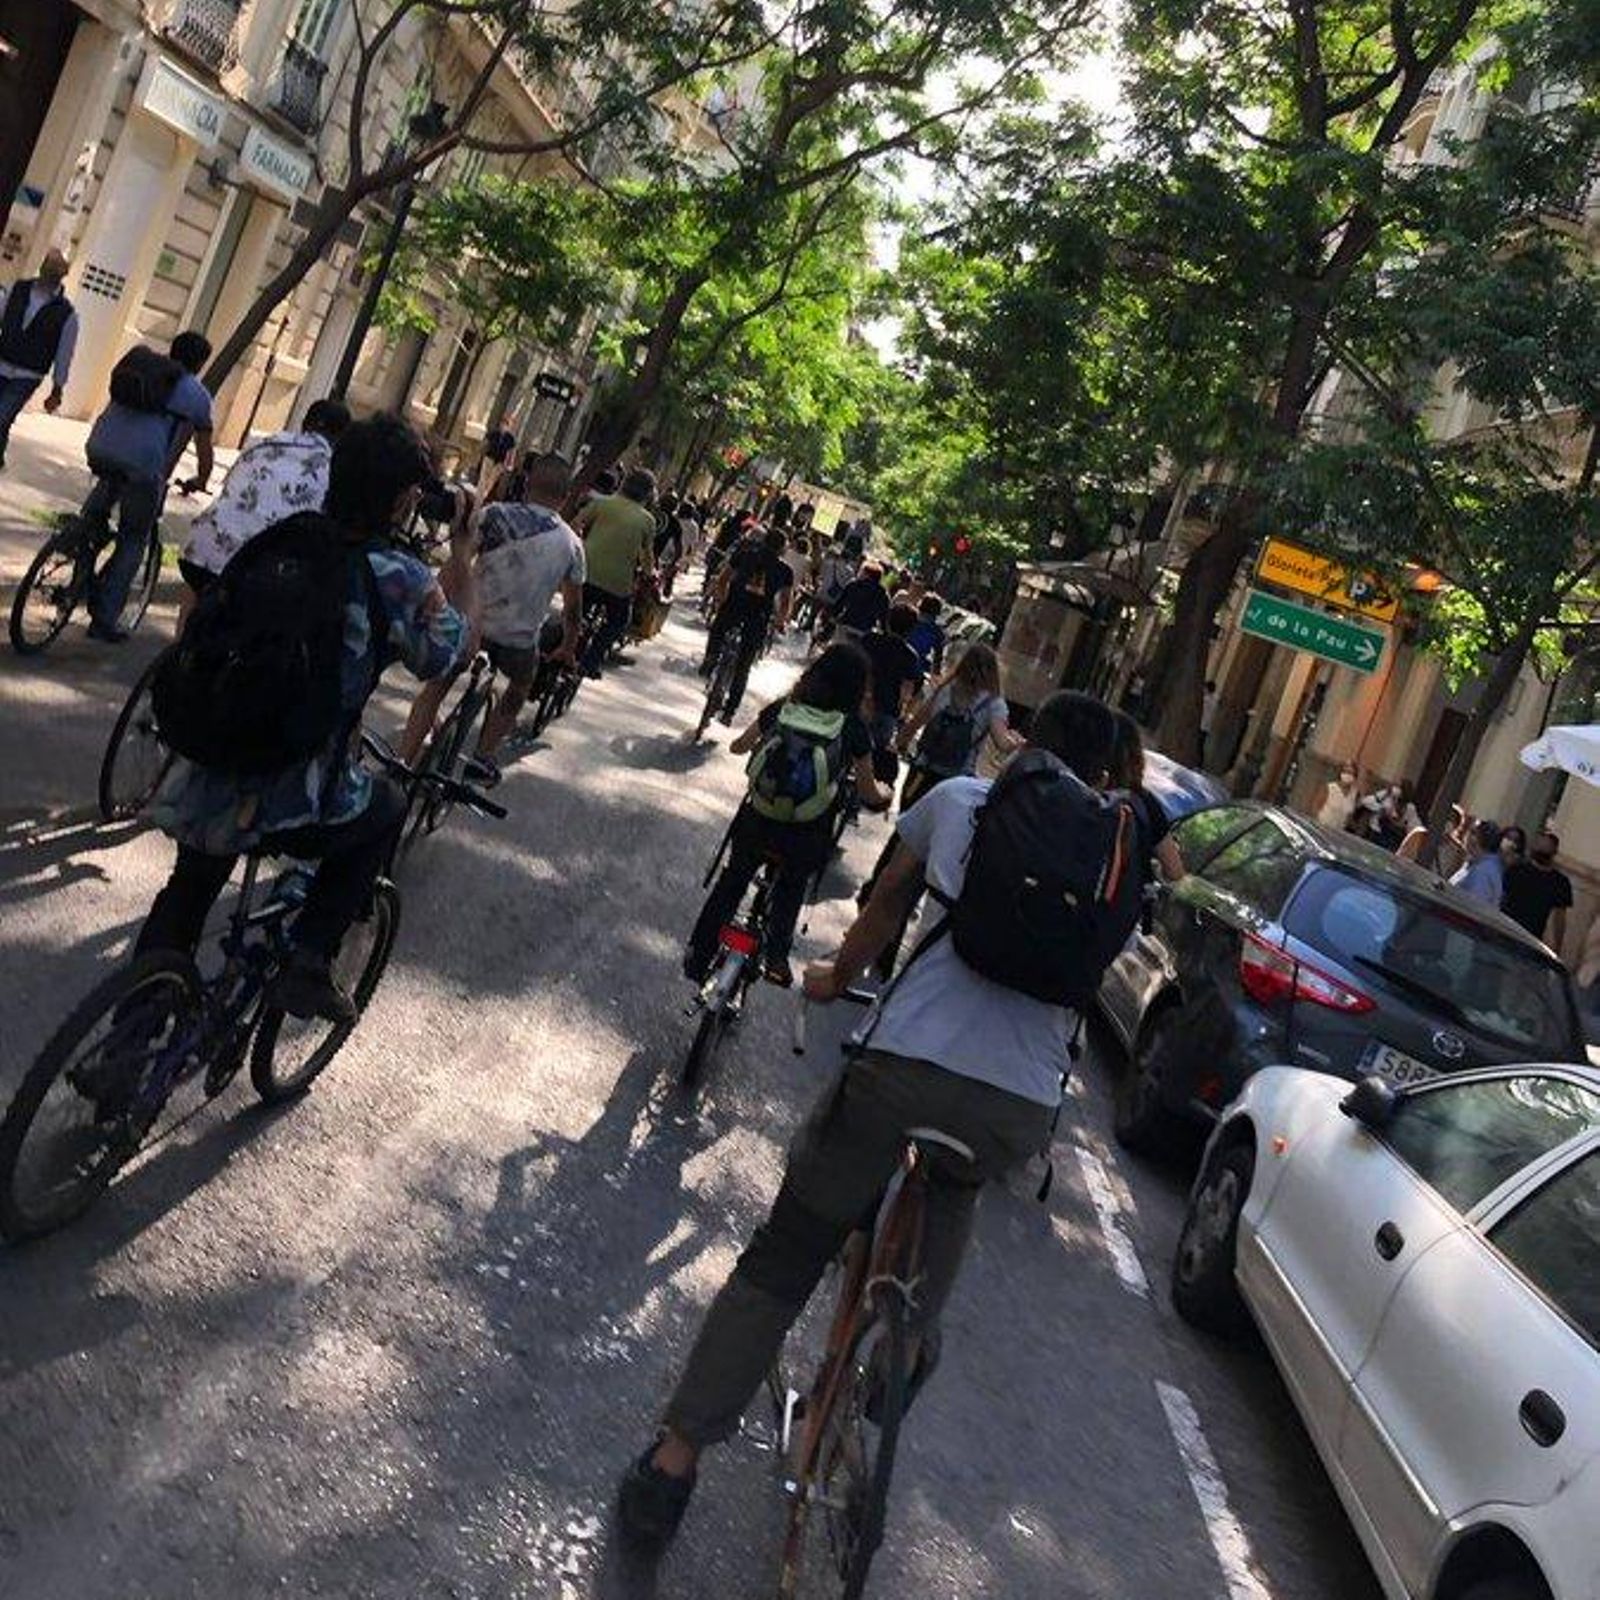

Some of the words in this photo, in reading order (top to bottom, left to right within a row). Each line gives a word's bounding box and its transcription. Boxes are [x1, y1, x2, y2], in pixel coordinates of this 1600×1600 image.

[1267, 612, 1288, 630] de
[1293, 620, 1309, 636] la
[1316, 628, 1348, 649] Pau
